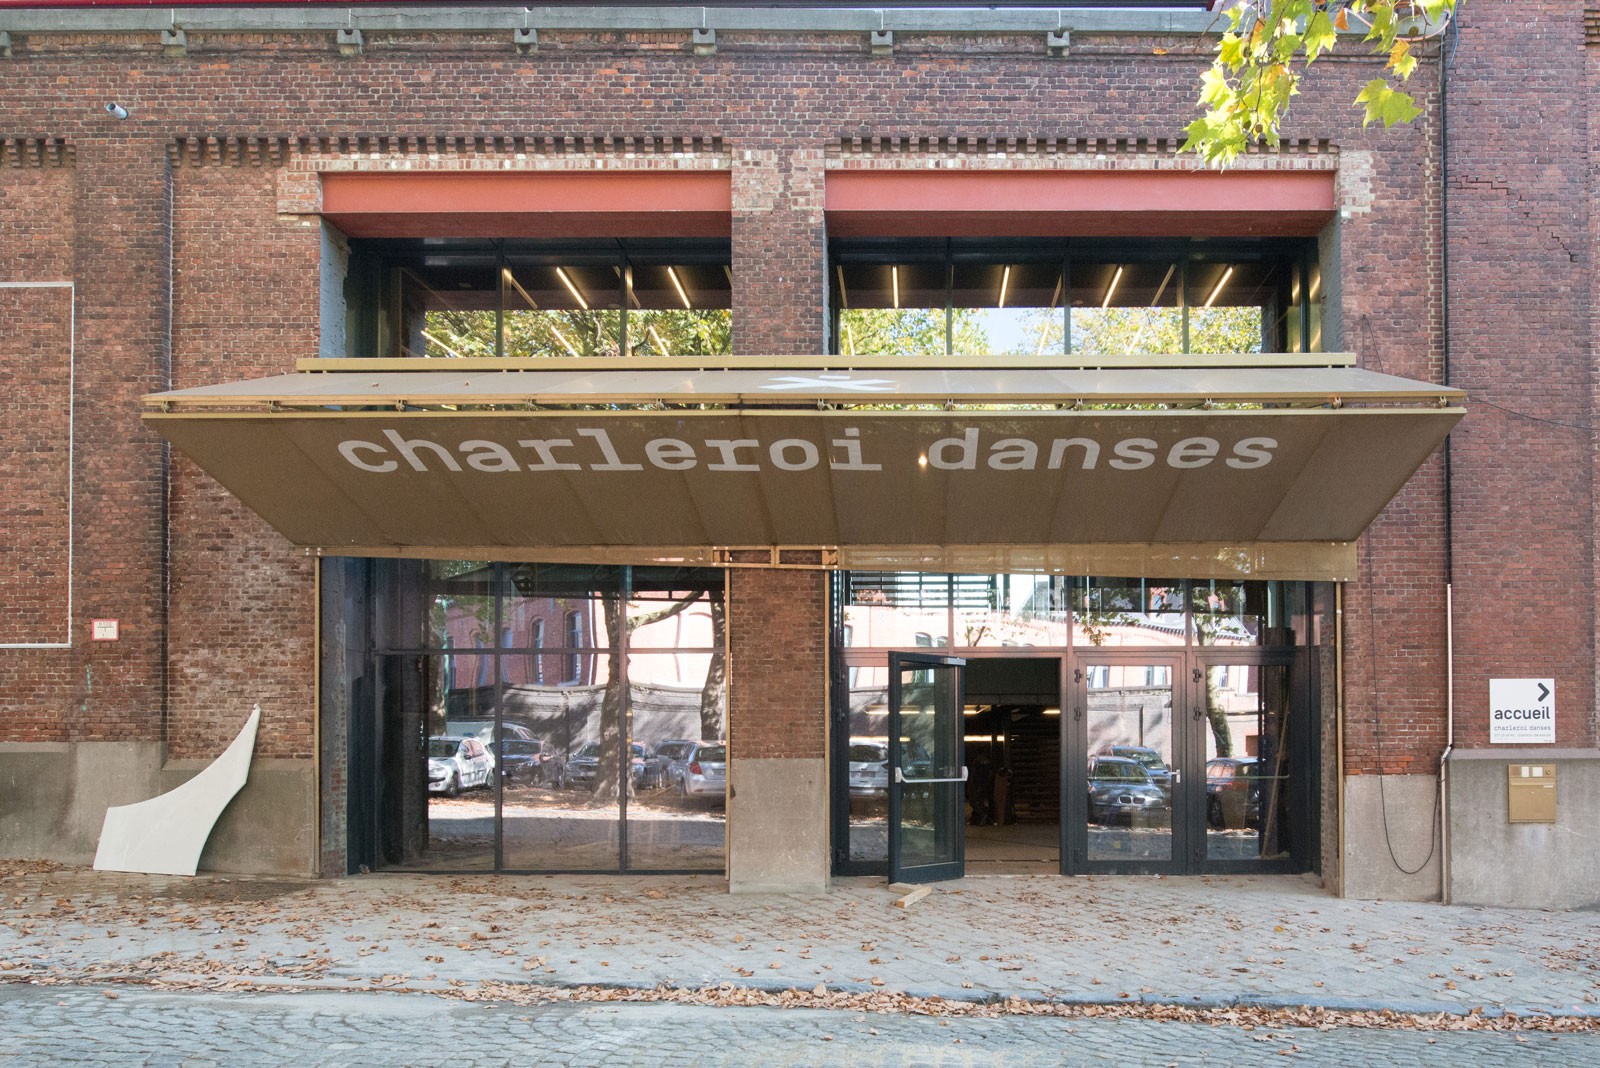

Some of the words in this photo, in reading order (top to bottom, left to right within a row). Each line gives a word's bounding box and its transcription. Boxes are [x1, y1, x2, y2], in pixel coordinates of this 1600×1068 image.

[337, 428, 883, 473] charleroi
[928, 427, 1279, 471] danses
[1494, 706, 1550, 720] accueil
